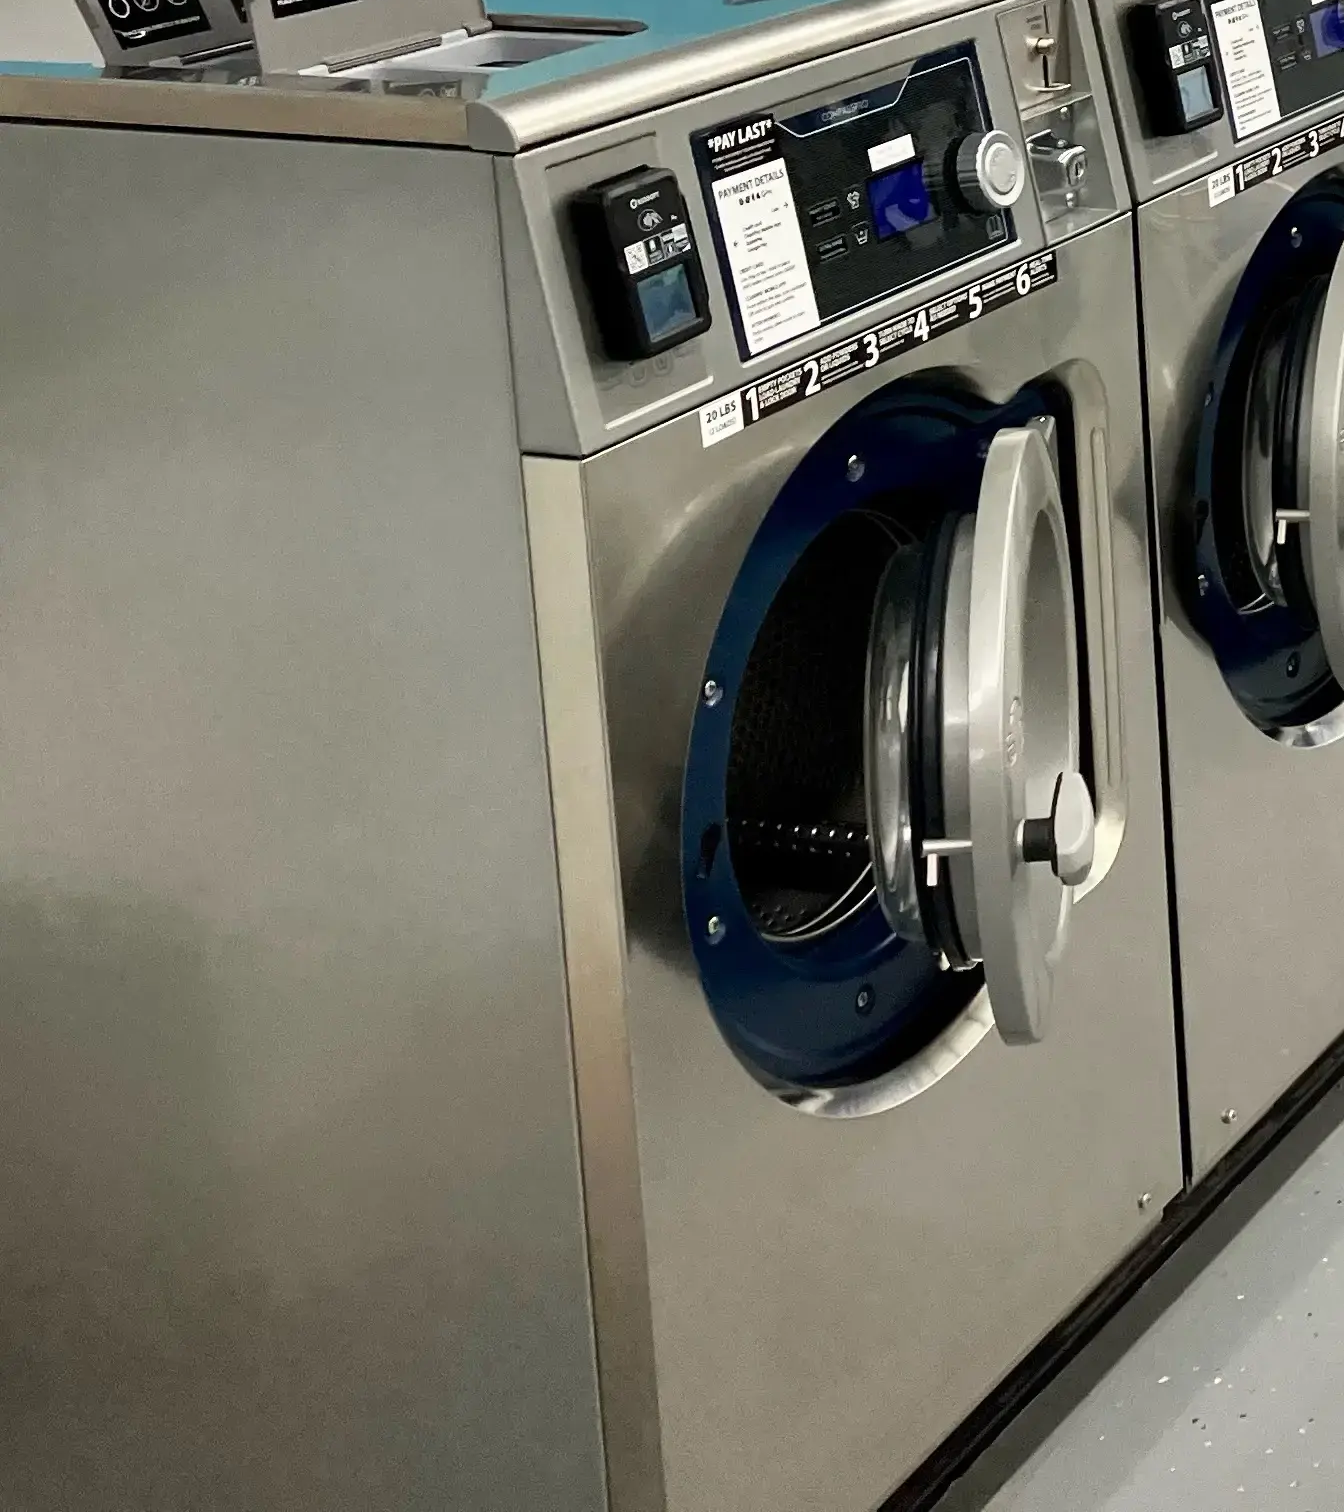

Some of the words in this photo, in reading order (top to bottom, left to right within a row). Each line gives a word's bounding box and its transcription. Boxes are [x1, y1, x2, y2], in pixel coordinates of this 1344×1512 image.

[1235, 164, 1245, 191] 1
[1271, 147, 1283, 176] 2
[1308, 130, 1320, 157] 3
[718, 179, 753, 200] PAYMENT
[754, 168, 785, 187] DETAILS
[1016, 262, 1031, 296] 6
[968, 284, 983, 319] 5
[913, 309, 930, 342] 4
[863, 333, 880, 368] 3
[803, 359, 822, 397] 2
[705, 409, 718, 424] 20
[719, 400, 737, 417] LBS
[745, 386, 760, 421] 1
